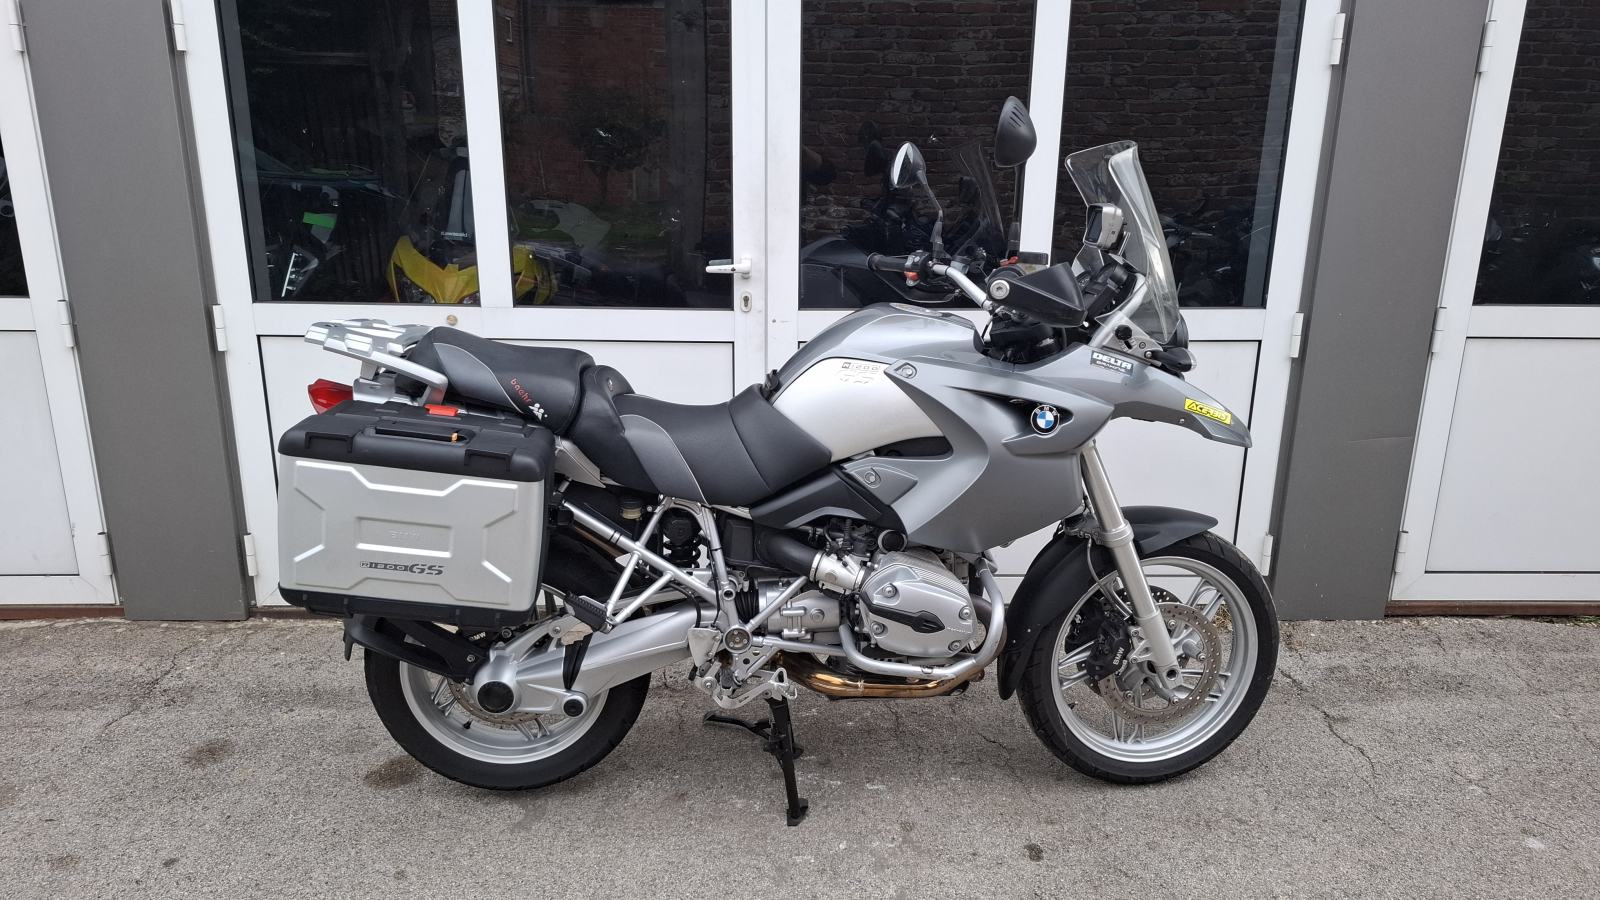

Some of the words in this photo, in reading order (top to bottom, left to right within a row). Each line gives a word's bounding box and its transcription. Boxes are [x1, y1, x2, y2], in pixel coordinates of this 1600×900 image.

[1092, 351, 1133, 370] DELTA
[1034, 405, 1058, 416] BMW
[1112, 646, 1125, 665] BMW
